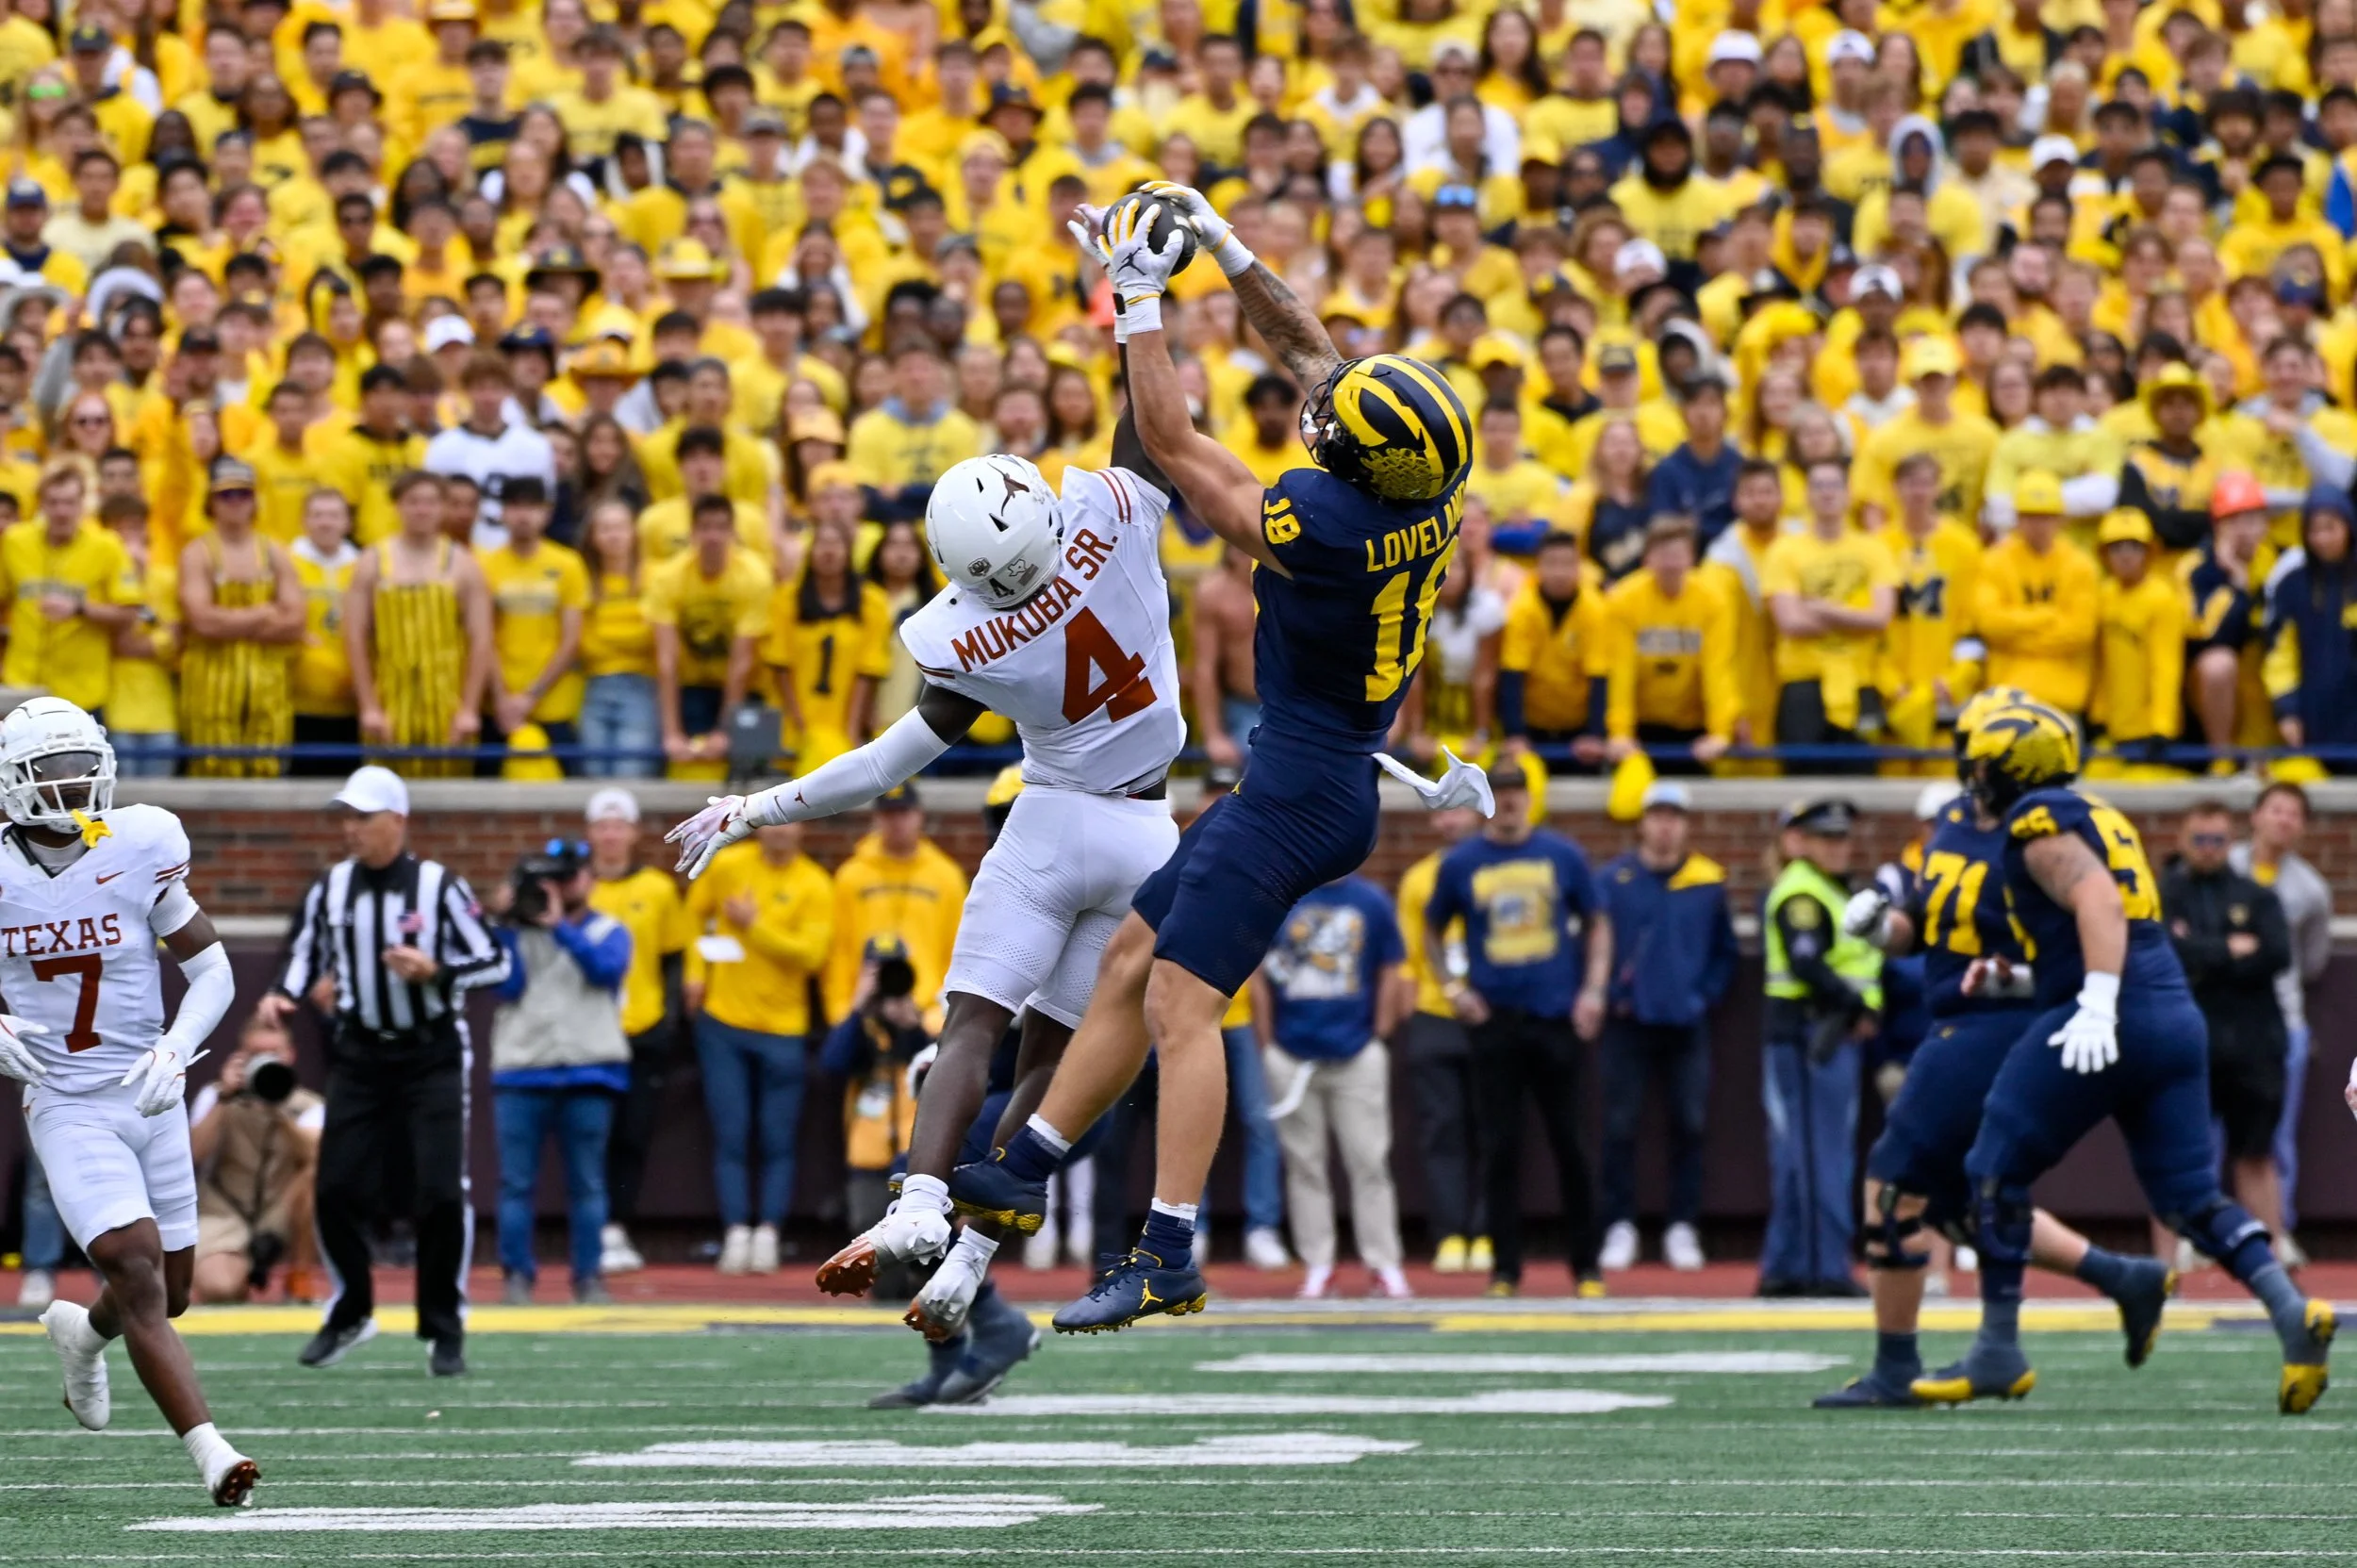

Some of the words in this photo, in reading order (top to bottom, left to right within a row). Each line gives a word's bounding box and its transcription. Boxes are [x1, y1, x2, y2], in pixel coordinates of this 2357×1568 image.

[1263, 497, 1302, 544] 18
[951, 576, 1082, 654] MUKUBA
[1065, 528, 1118, 581] SR.
[1897, 576, 1944, 619] M
[814, 634, 833, 694] 1
[1062, 605, 1158, 723] 4
[1, 913, 122, 958] TEXAS
[1924, 850, 1989, 956] 71
[31, 952, 103, 1053] 7
